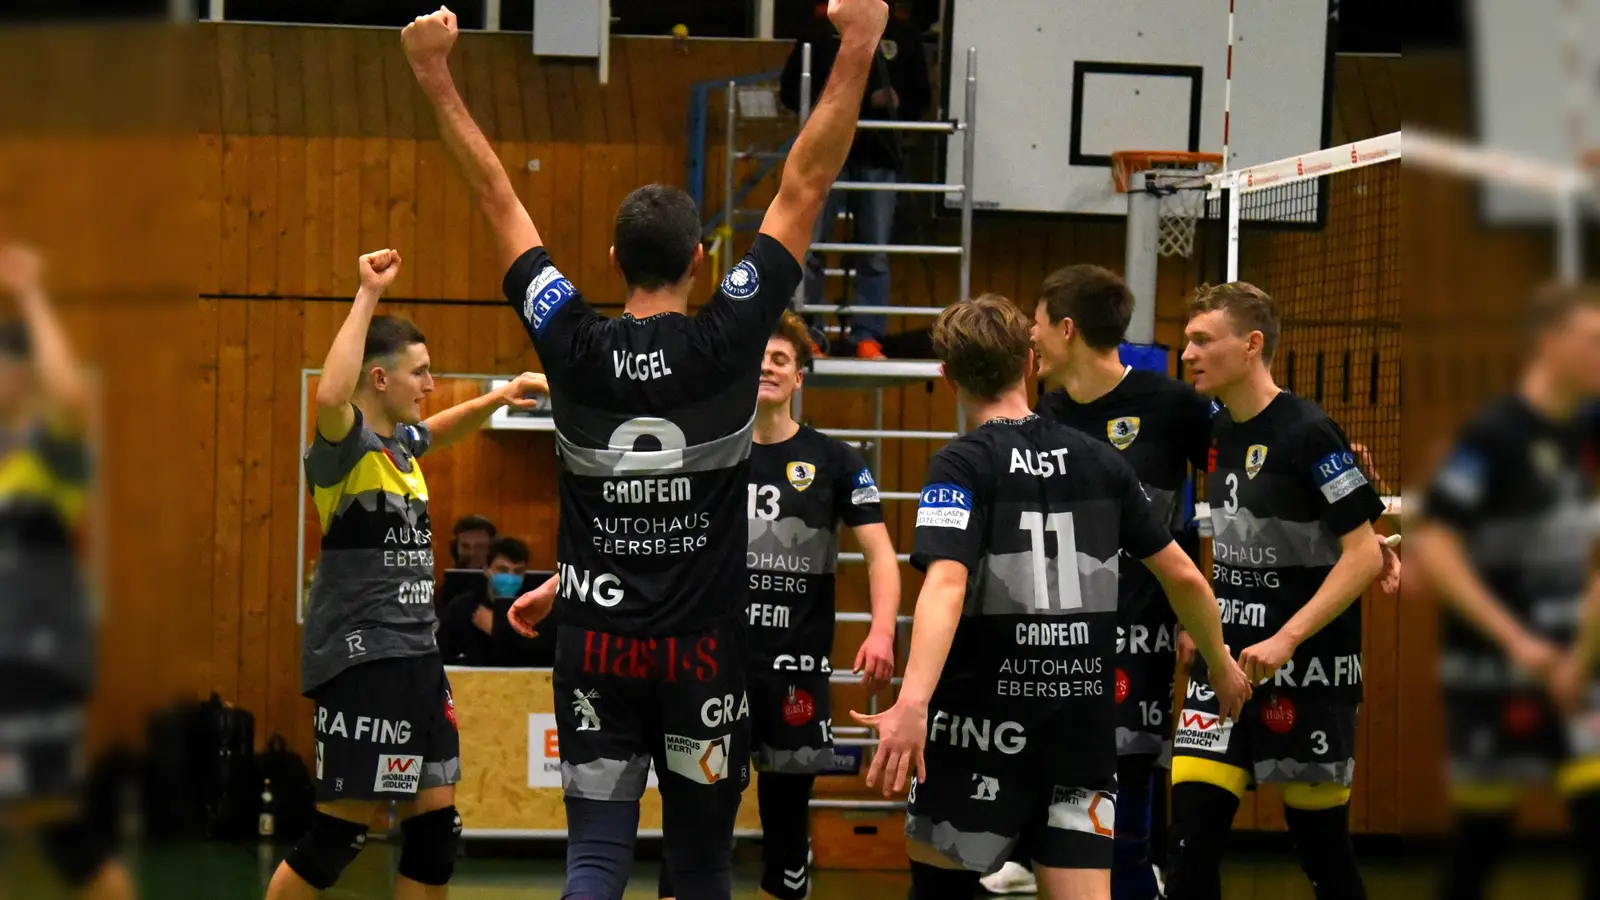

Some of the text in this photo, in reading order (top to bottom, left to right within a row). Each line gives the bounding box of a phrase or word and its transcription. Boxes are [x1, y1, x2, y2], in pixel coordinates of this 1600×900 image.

[613, 350, 672, 381] VOGEL
[1009, 448, 1069, 479] AUST
[603, 477, 692, 504] CADFEM
[1223, 473, 1239, 515] 3
[593, 512, 710, 534] AUTOHAUS
[592, 533, 708, 556] EBERSBERG
[1019, 511, 1083, 610] 11
[556, 562, 625, 607] ING
[745, 603, 790, 628] FEM
[1015, 621, 1090, 647] CADFEM
[999, 657, 1103, 676] AUTOHAUS
[997, 679, 1103, 698] EBERSBERG
[1139, 700, 1163, 726] 16
[666, 736, 700, 751] MARCUS
[667, 744, 692, 756] KERTI
[1309, 730, 1329, 755] 3
